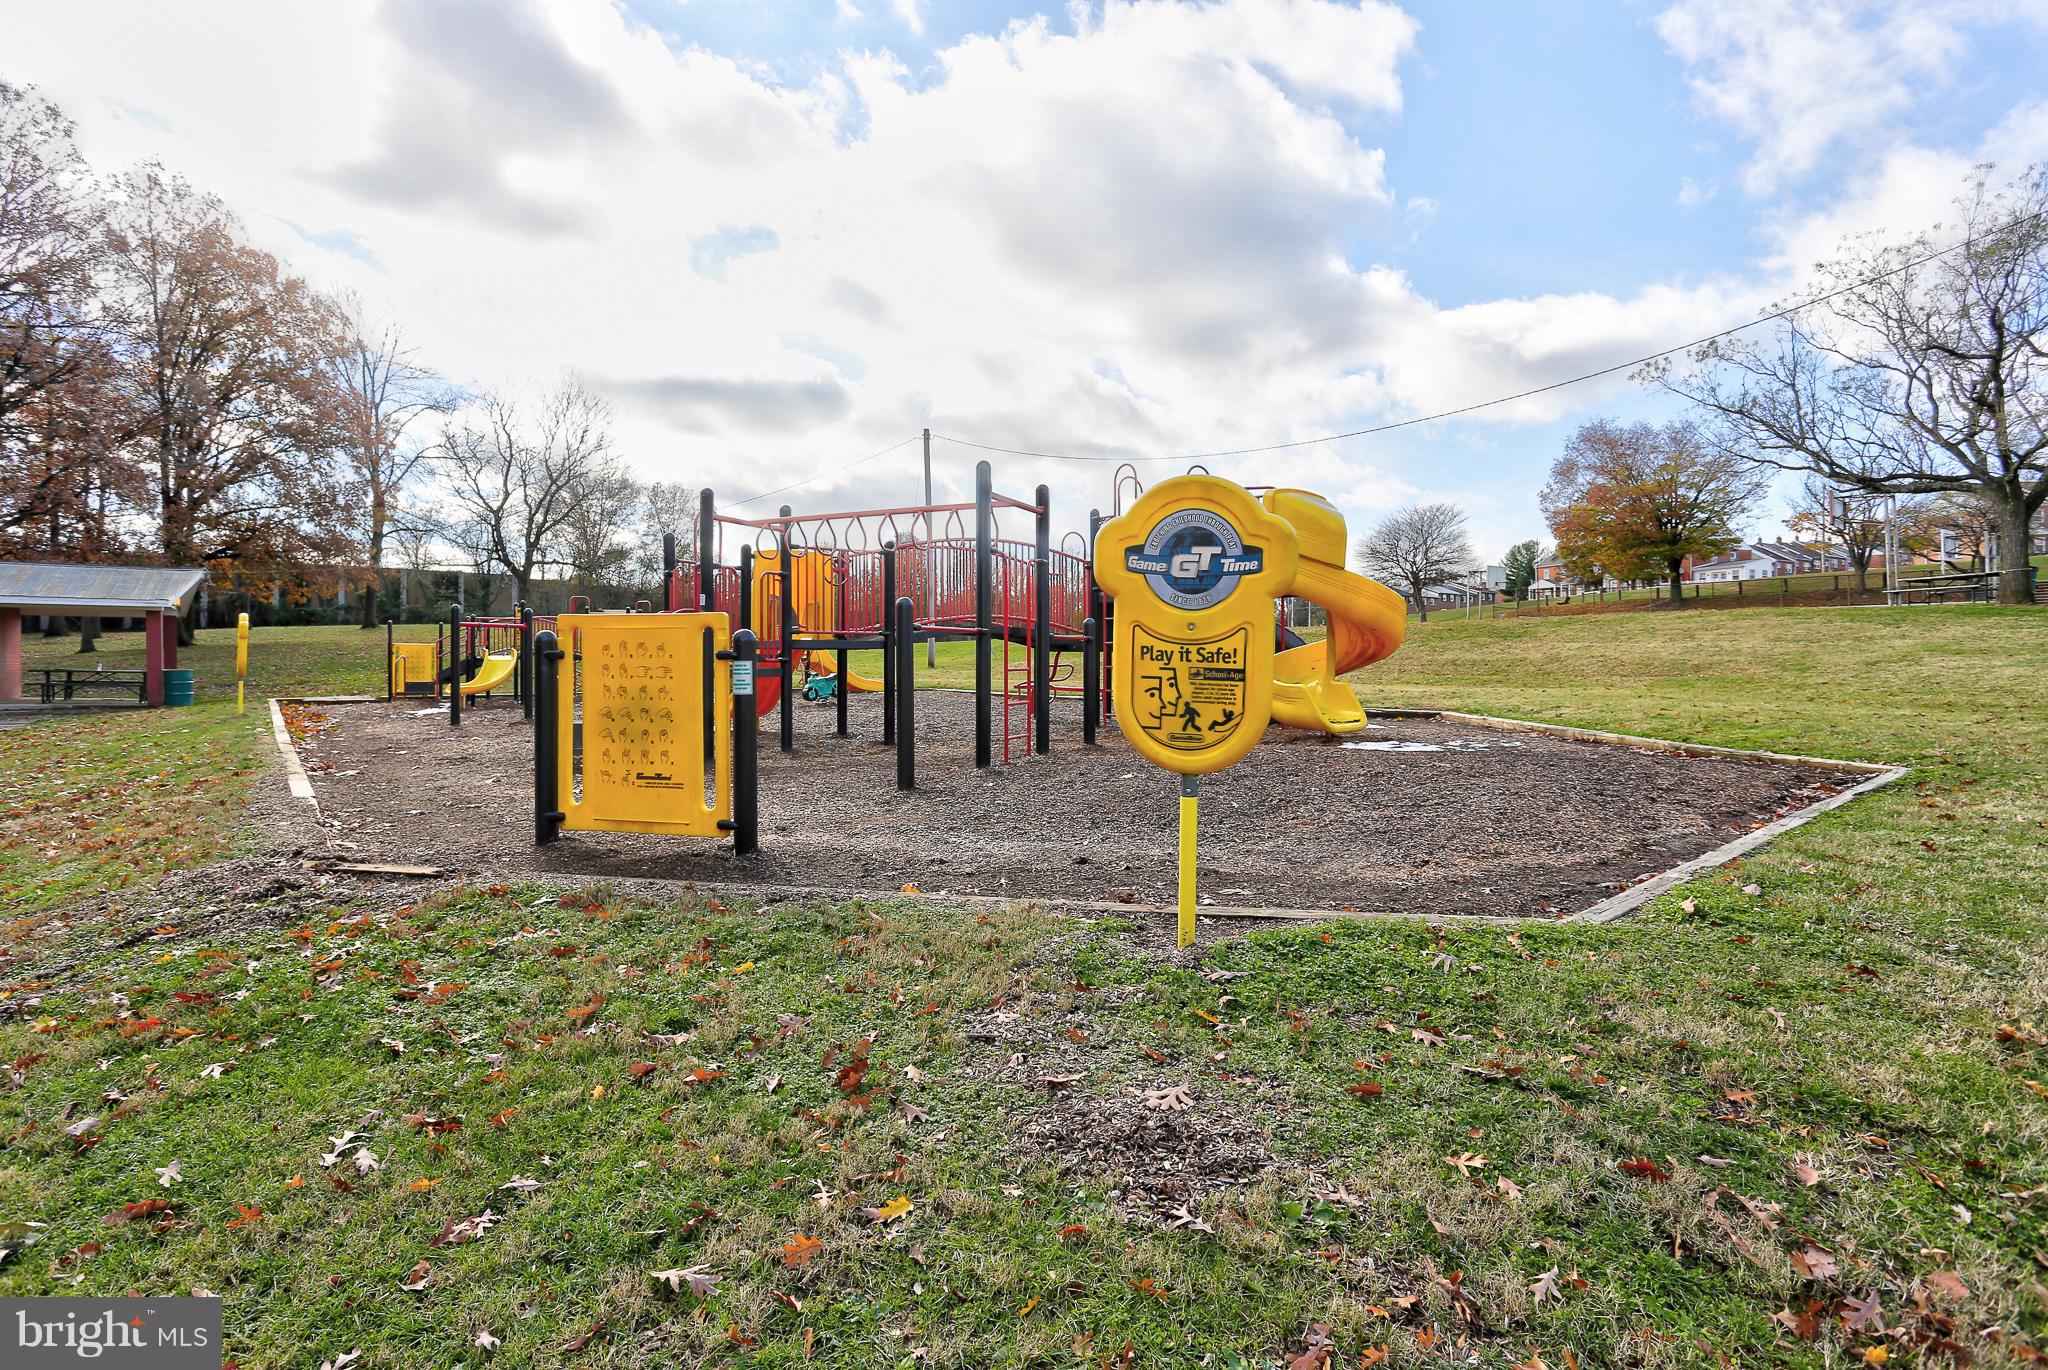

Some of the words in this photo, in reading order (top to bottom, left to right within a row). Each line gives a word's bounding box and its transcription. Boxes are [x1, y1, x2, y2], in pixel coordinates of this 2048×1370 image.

[1127, 555, 1169, 572] Game
[1170, 545, 1222, 578] GT
[1220, 558, 1259, 573] Time
[1140, 645, 1174, 666] Play
[1178, 646, 1192, 662] it
[1196, 647, 1238, 664] Safe!
